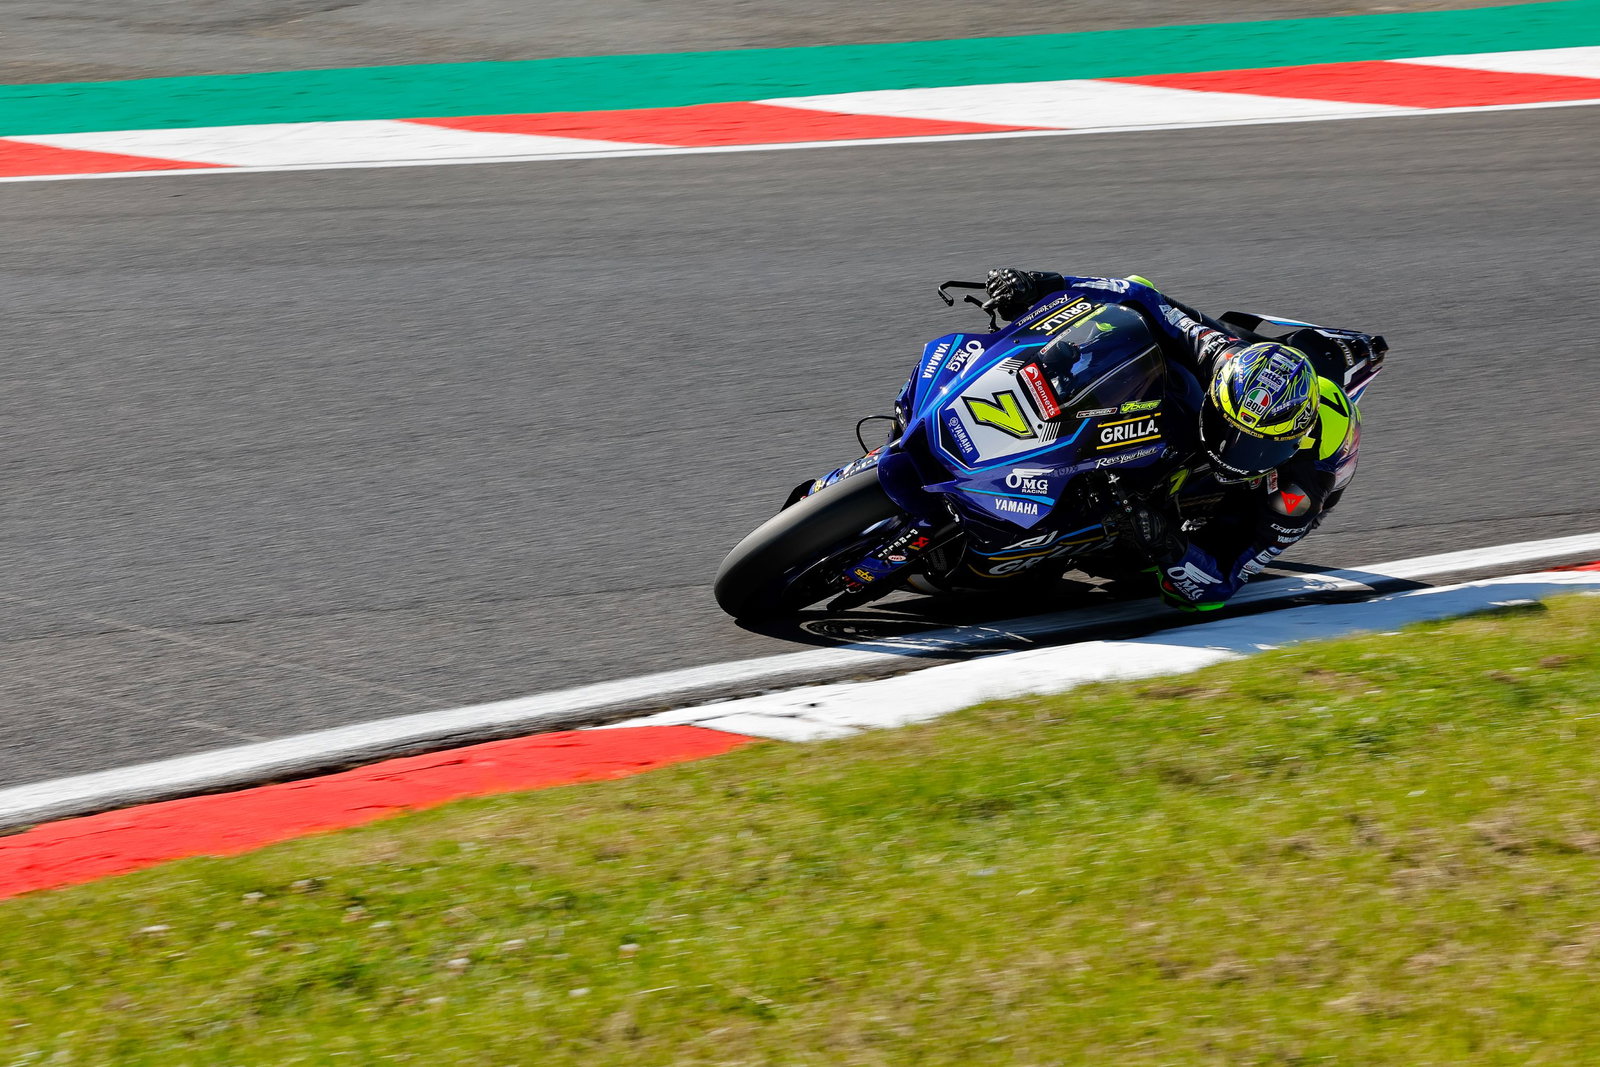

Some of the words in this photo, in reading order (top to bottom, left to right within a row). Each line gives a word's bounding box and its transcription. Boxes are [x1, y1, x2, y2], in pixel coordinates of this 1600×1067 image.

[922, 343, 951, 379] YAMAHA
[1034, 380, 1056, 416] Bennetts
[1246, 400, 1265, 413] agv
[960, 389, 1039, 440] 7
[953, 424, 974, 454] YAMAHA
[1005, 470, 1049, 491] OMG
[995, 498, 1038, 515] YAMAHA
[877, 528, 918, 558] PIRELLI
[854, 568, 875, 582] sbs
